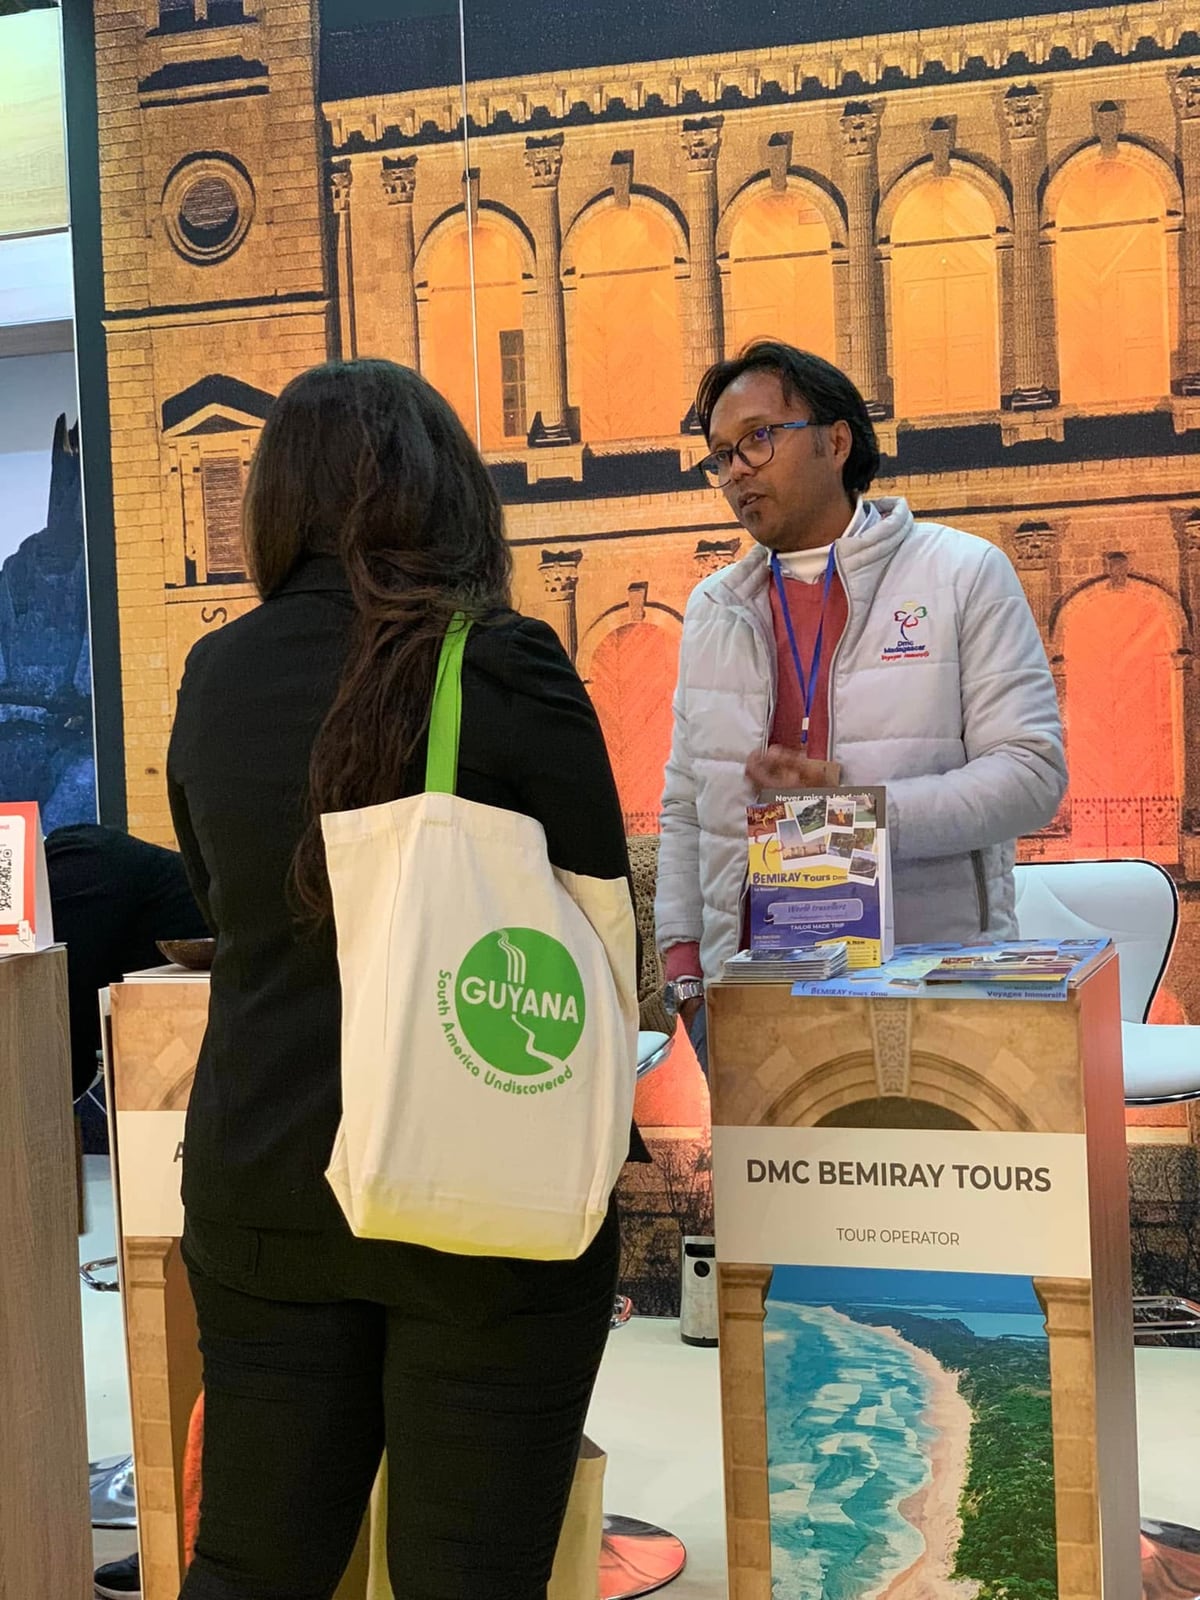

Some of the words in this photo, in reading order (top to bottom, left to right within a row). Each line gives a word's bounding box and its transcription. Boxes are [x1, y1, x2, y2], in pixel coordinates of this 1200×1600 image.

[775, 794, 801, 802] Never
[752, 872, 802, 884] BEMIRAY
[803, 874, 831, 883] Tours
[436, 969, 453, 1016] South
[460, 976, 580, 1024] GUYANA
[441, 1021, 481, 1077] America
[484, 1065, 573, 1095] Undiscovered
[746, 1159, 810, 1184] DMC
[818, 1161, 945, 1188] BEMIRAY
[952, 1164, 1052, 1192] TOURS
[836, 1227, 877, 1243] TOUR
[879, 1229, 960, 1246] OPERATOR
